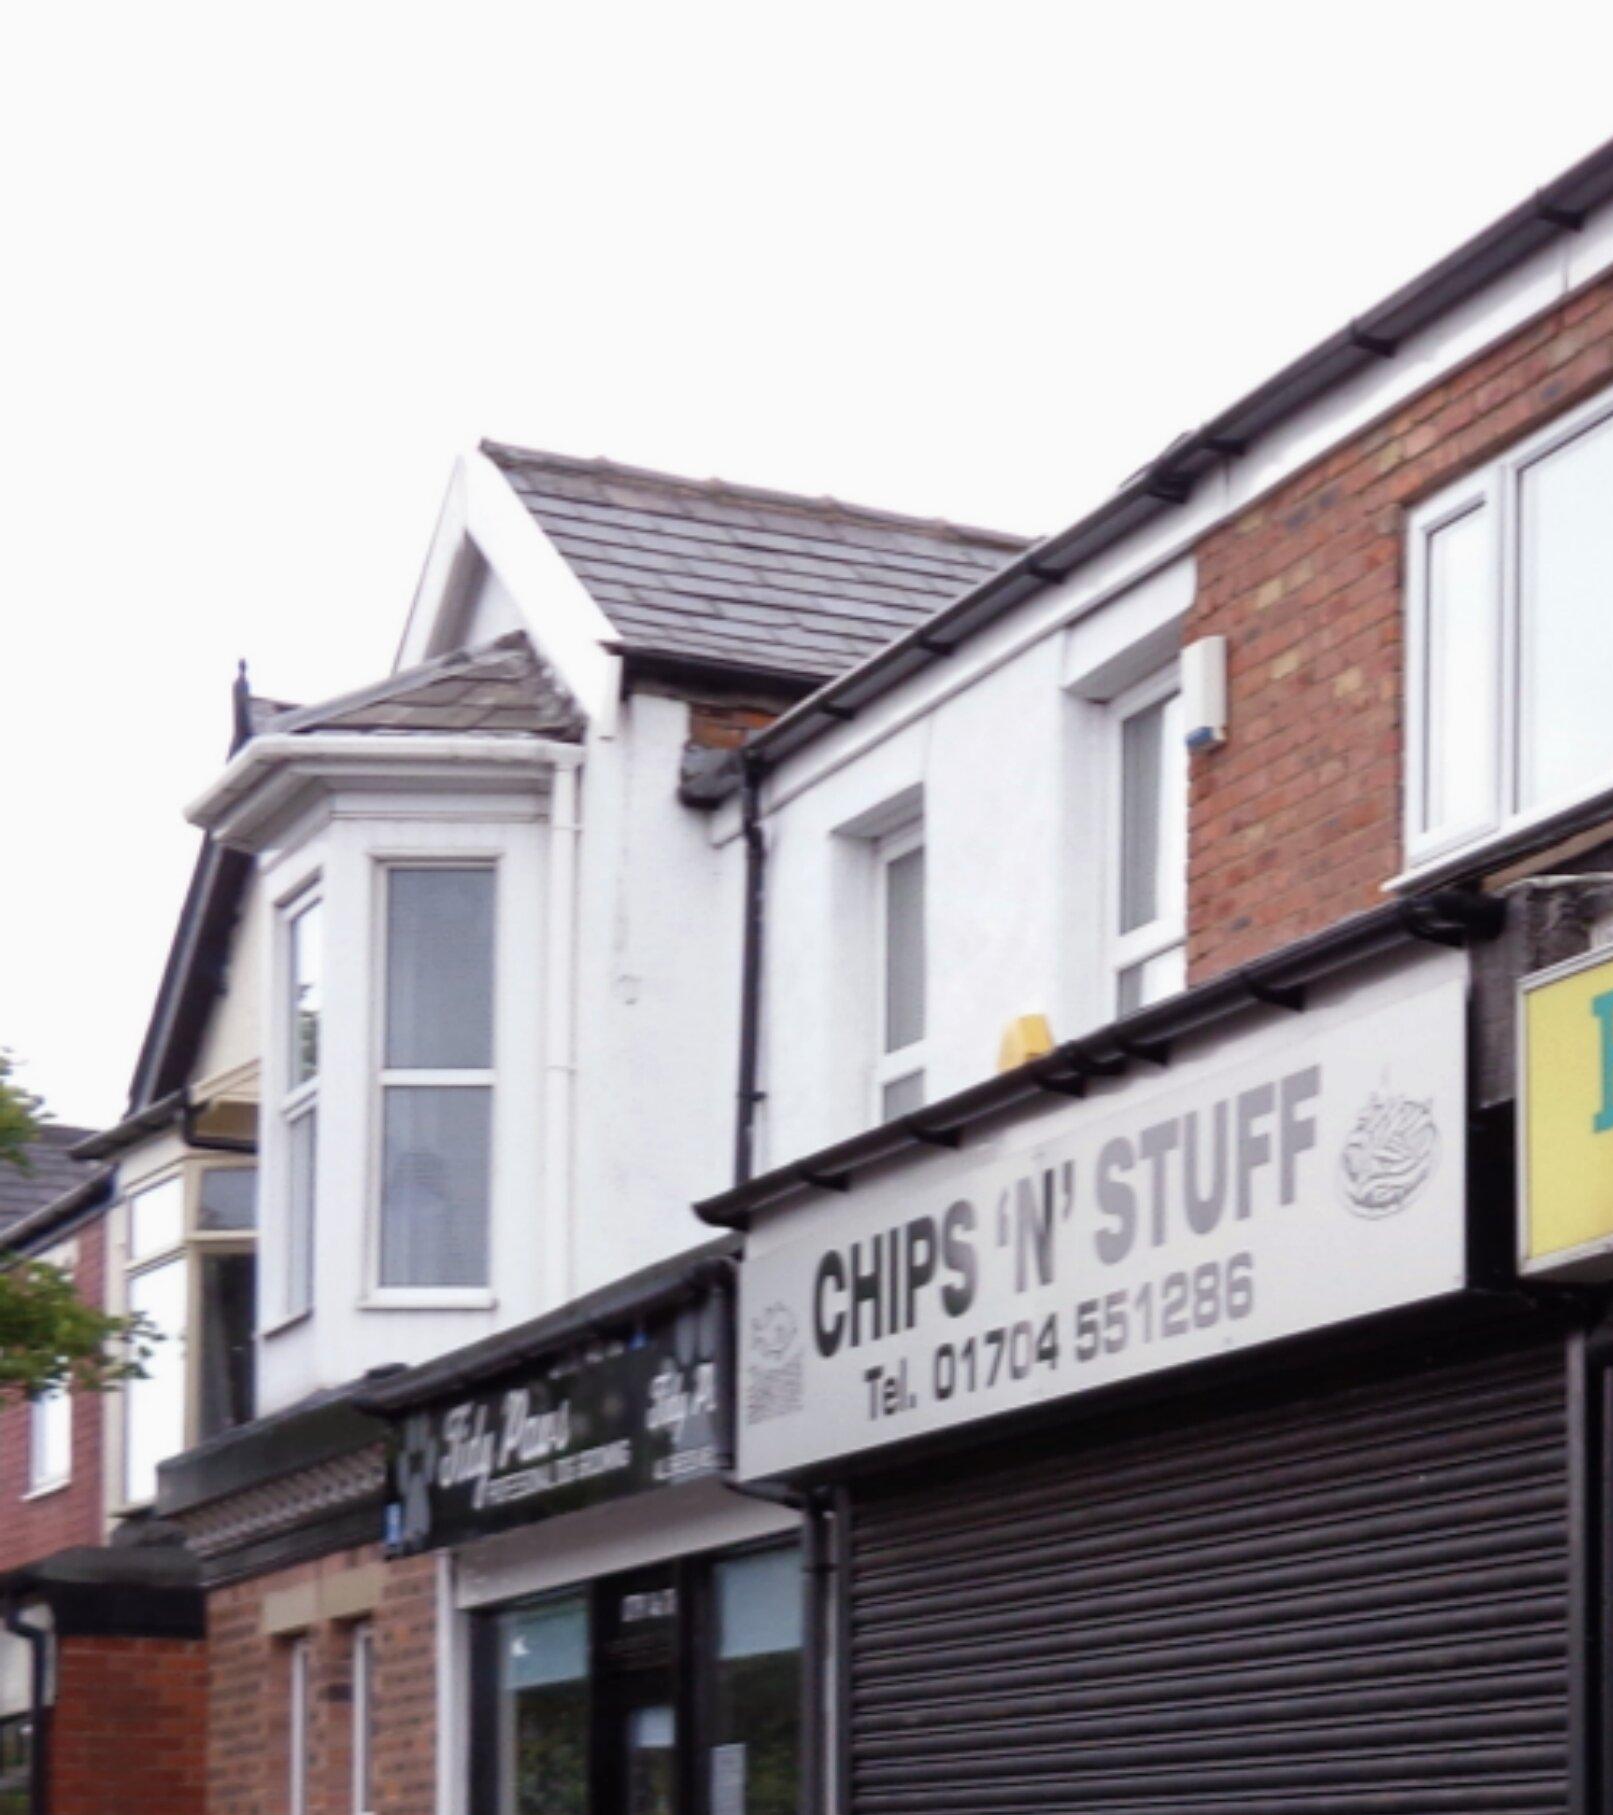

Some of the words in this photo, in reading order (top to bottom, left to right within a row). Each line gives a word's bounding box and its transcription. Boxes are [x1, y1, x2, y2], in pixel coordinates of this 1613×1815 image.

[813, 1198, 978, 1359] CHIPS
[1094, 1063, 1322, 1266] STUFF
[864, 1365, 918, 1421] Tel.
[933, 1312, 1060, 1400] 01704
[1074, 1252, 1254, 1364] 551286
